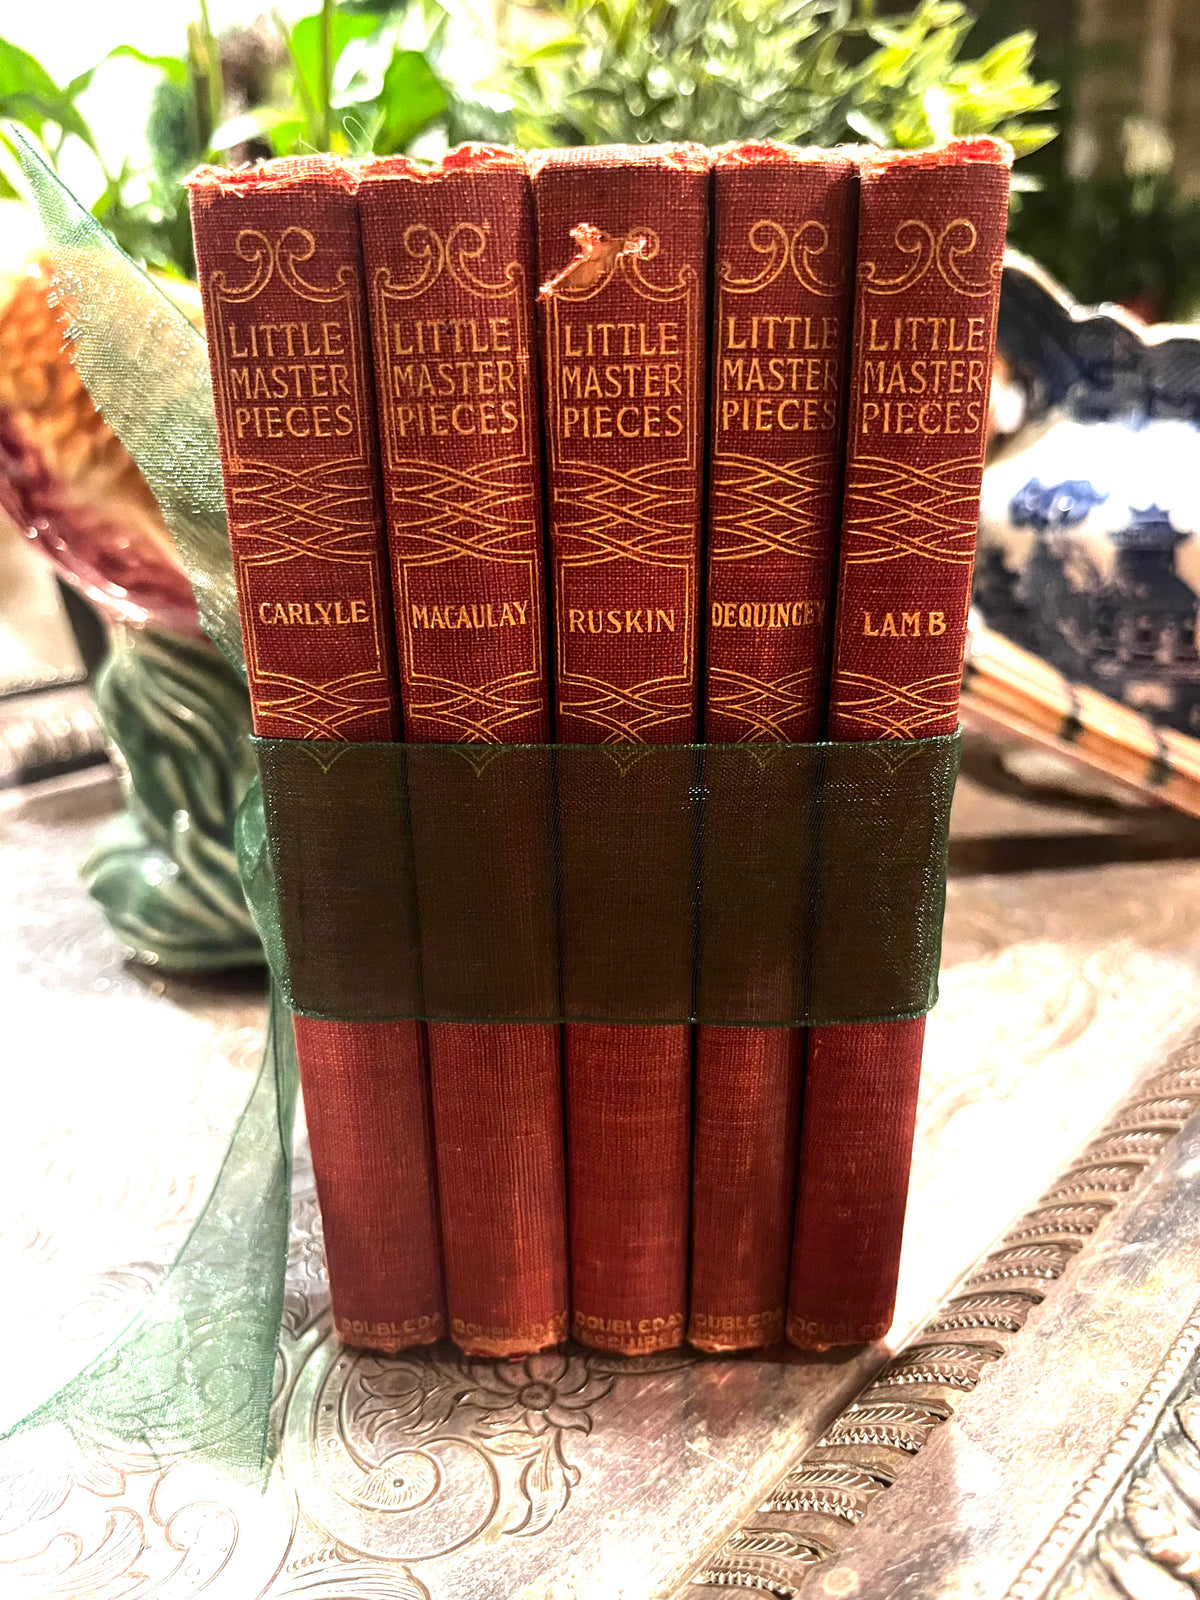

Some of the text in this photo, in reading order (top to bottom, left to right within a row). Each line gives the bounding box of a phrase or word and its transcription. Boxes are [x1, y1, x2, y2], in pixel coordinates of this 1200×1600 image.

[229, 322, 345, 357] LITTLE
[394, 318, 512, 355] LITTLE
[564, 322, 680, 357] LITTLE
[727, 316, 840, 350] LITTLE
[868, 317, 985, 351] LITTLE
[230, 364, 351, 400] MASTER
[393, 360, 516, 397] MASTER
[562, 363, 682, 399] MASTER
[723, 358, 839, 392] MASTER
[864, 359, 984, 394] MASTER
[235, 404, 353, 438] PIECES
[397, 400, 518, 437] PIECES
[563, 405, 683, 438] PIECES
[722, 398, 837, 431] PIECES
[862, 401, 981, 435] PIECES
[258, 600, 370, 625] CARLYLE
[411, 600, 529, 629] MACAULAY
[568, 608, 676, 635] RUSKIN
[863, 610, 947, 637] LAMB
